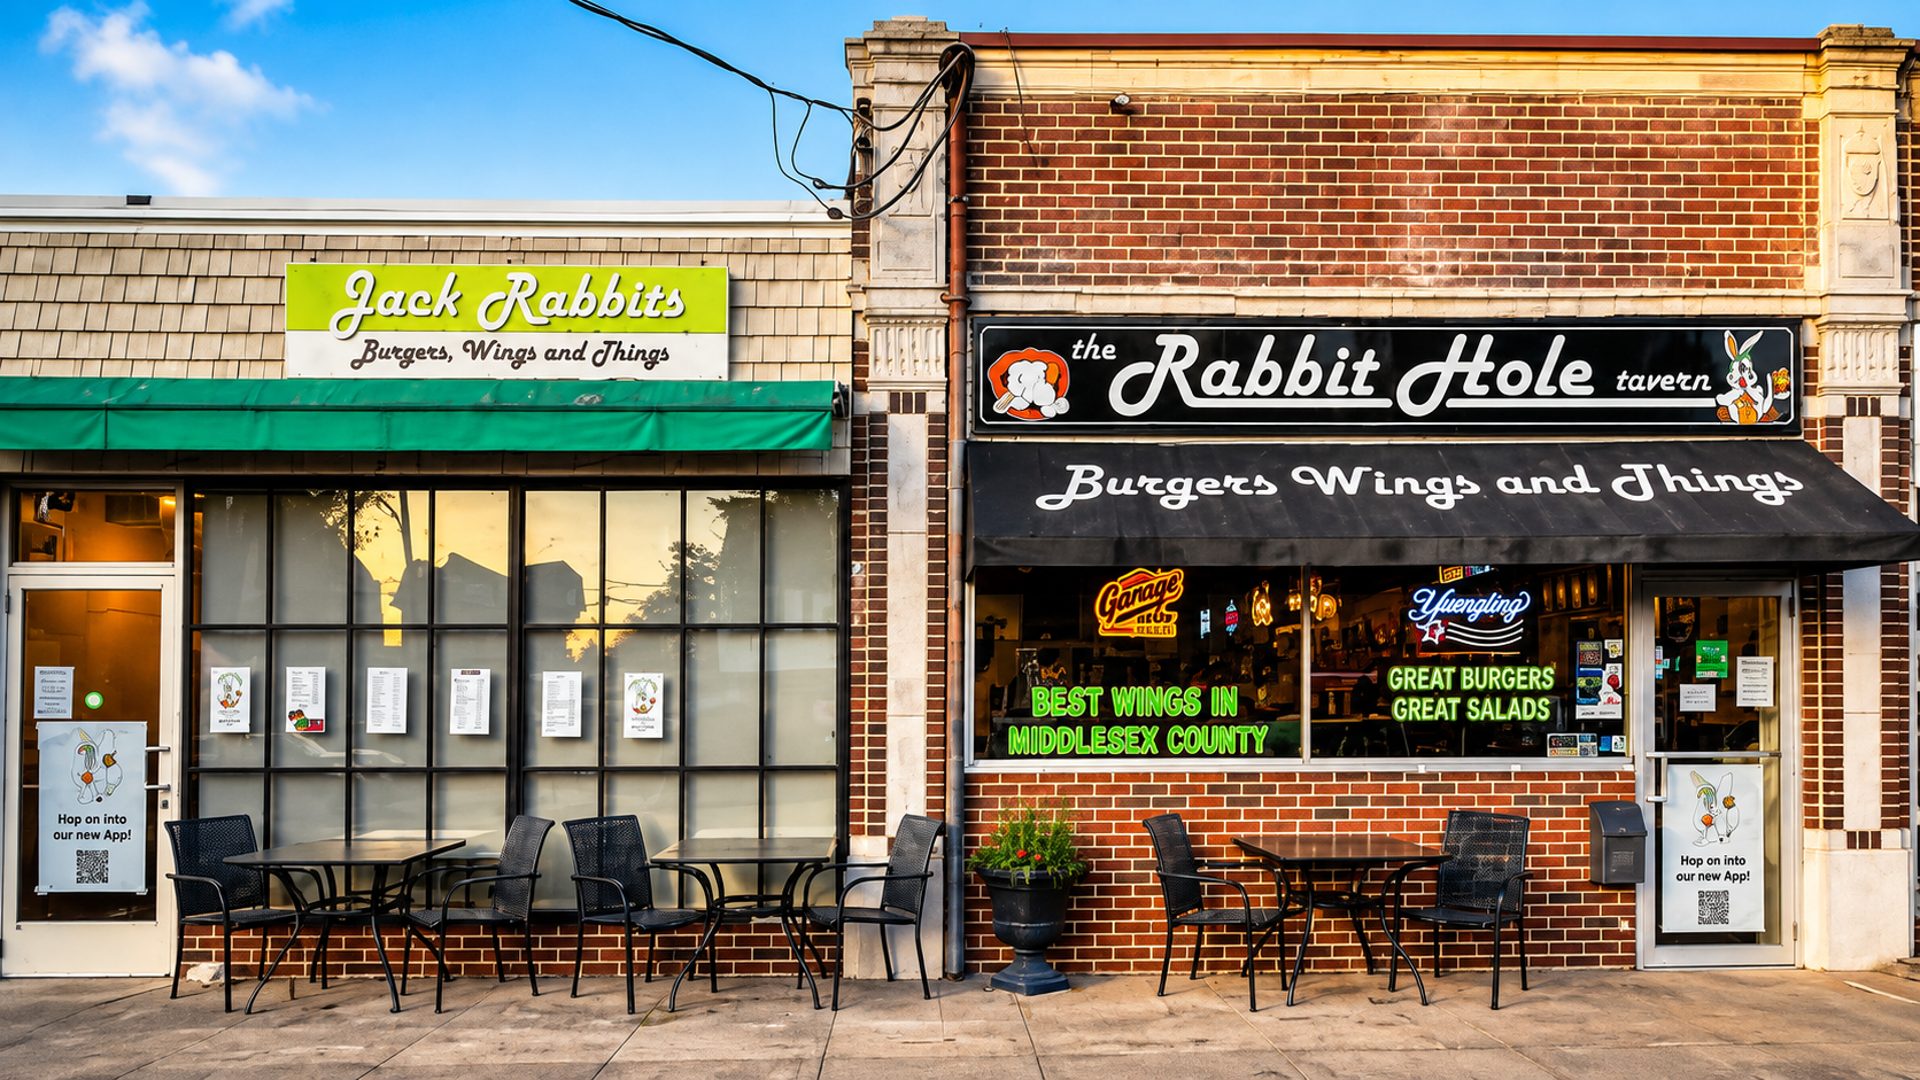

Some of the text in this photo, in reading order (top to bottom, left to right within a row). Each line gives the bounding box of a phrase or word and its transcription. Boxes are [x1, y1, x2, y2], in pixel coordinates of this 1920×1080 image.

[329, 269, 686, 340] Jack Rabbits
[351, 339, 670, 370] Burgers, Wings and Things
[1072, 333, 1712, 417] the Rabbit Hole tavern
[1035, 463, 1804, 511] Burgers Wings and Things
[1408, 587, 1531, 623] Yuengling
[1388, 666, 1555, 691] GREAT BURGERS
[1031, 686, 1238, 718] BEST WINGS IN
[1392, 696, 1551, 721] GREAT SALADS
[1008, 725, 1269, 755] MIDDLESEX COUNTY
[57, 813, 127, 827] Hop on into
[53, 829, 132, 843] our new App!
[1676, 870, 1750, 884] our new App!
[1680, 855, 1746, 869] Hop on into
